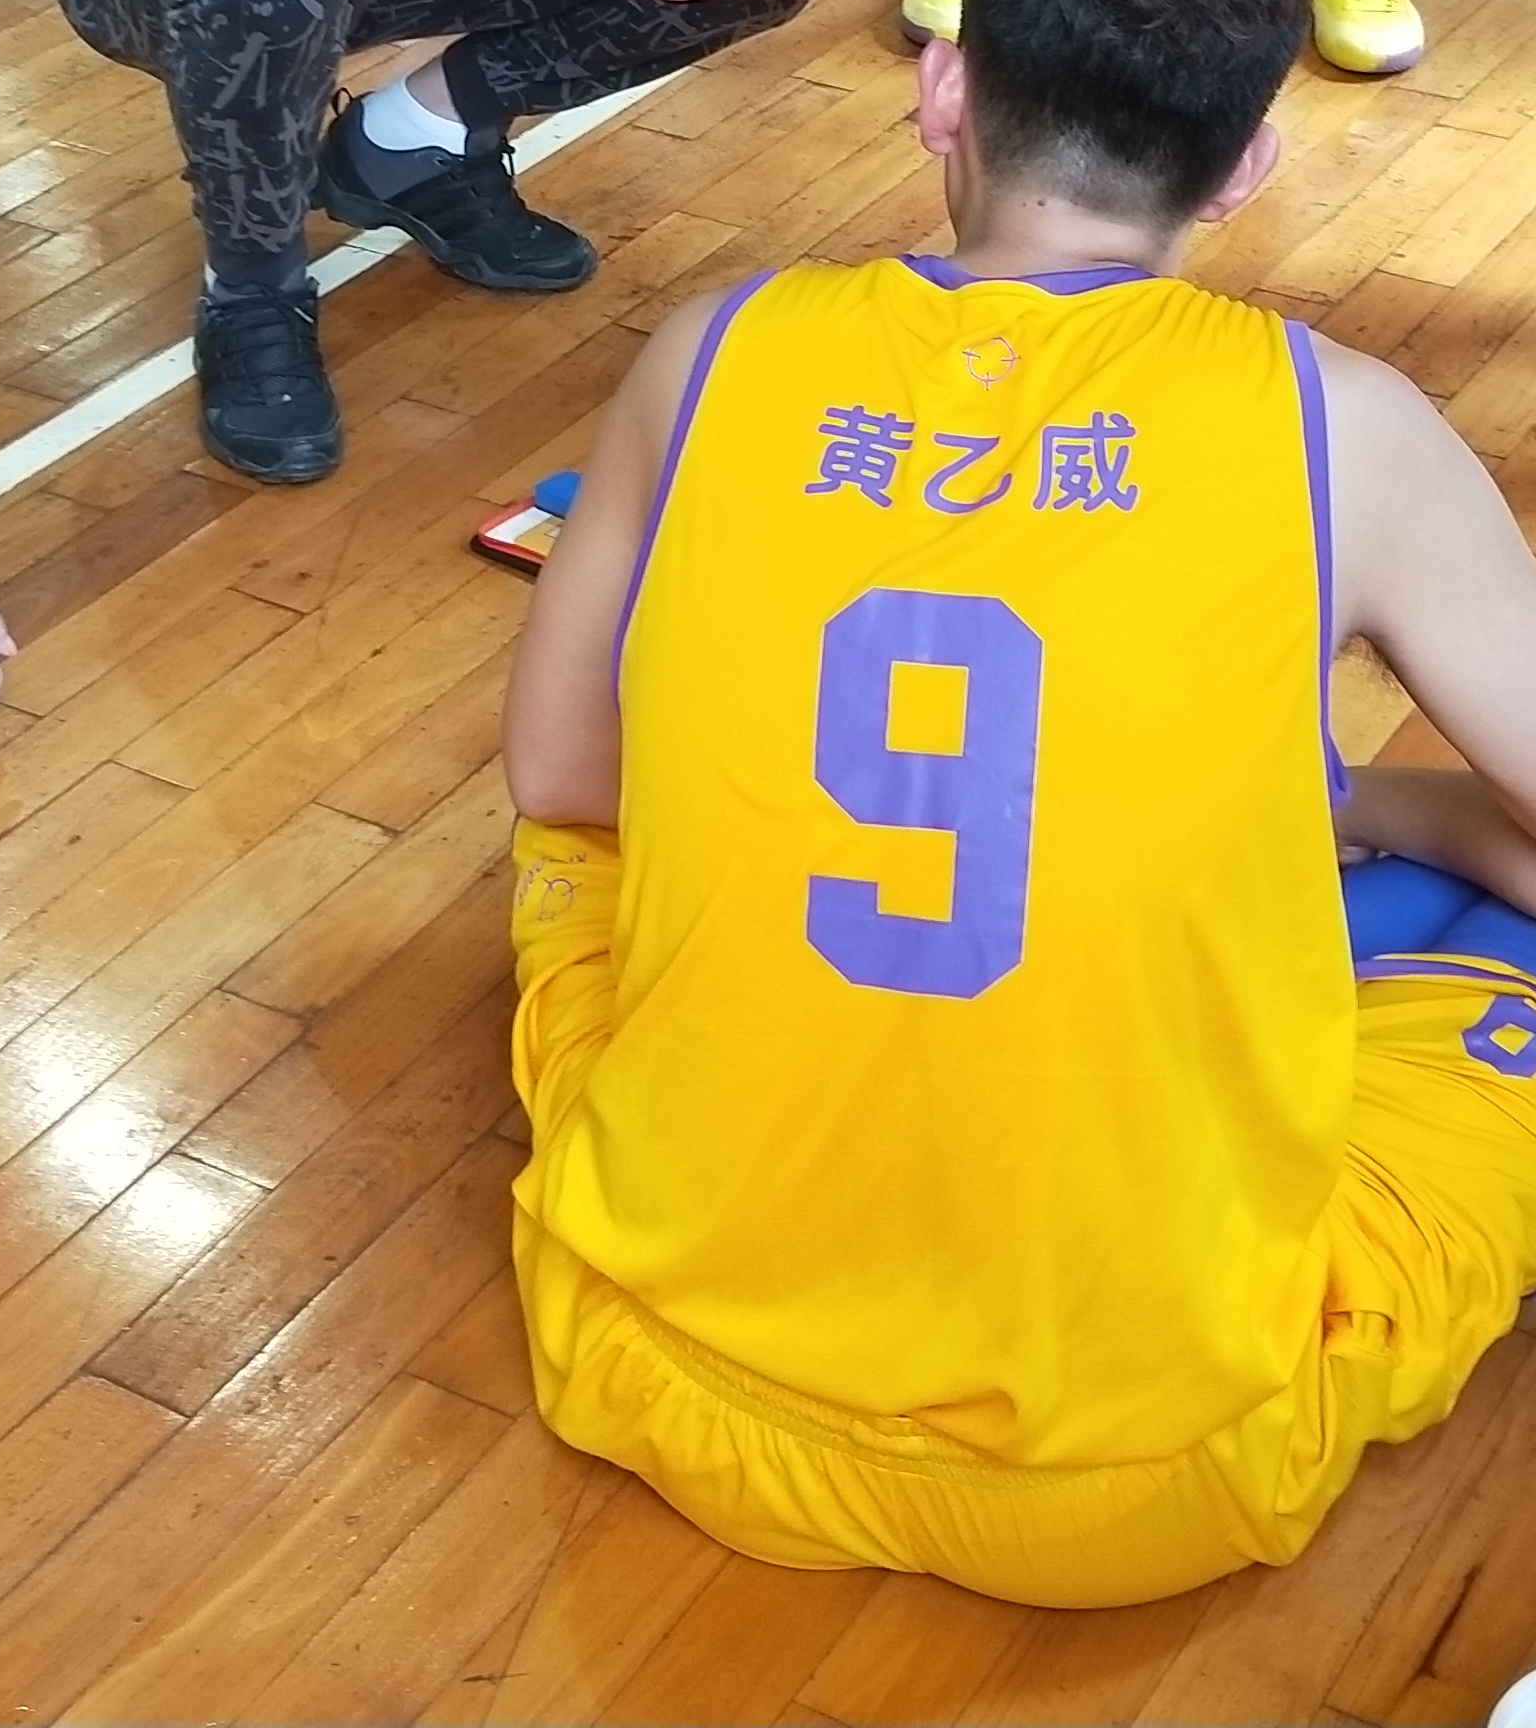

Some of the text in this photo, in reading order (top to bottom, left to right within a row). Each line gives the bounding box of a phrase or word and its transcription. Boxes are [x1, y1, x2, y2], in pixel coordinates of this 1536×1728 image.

[804, 404, 1138, 514] 黄乙威
[805, 586, 1044, 1001] 9
